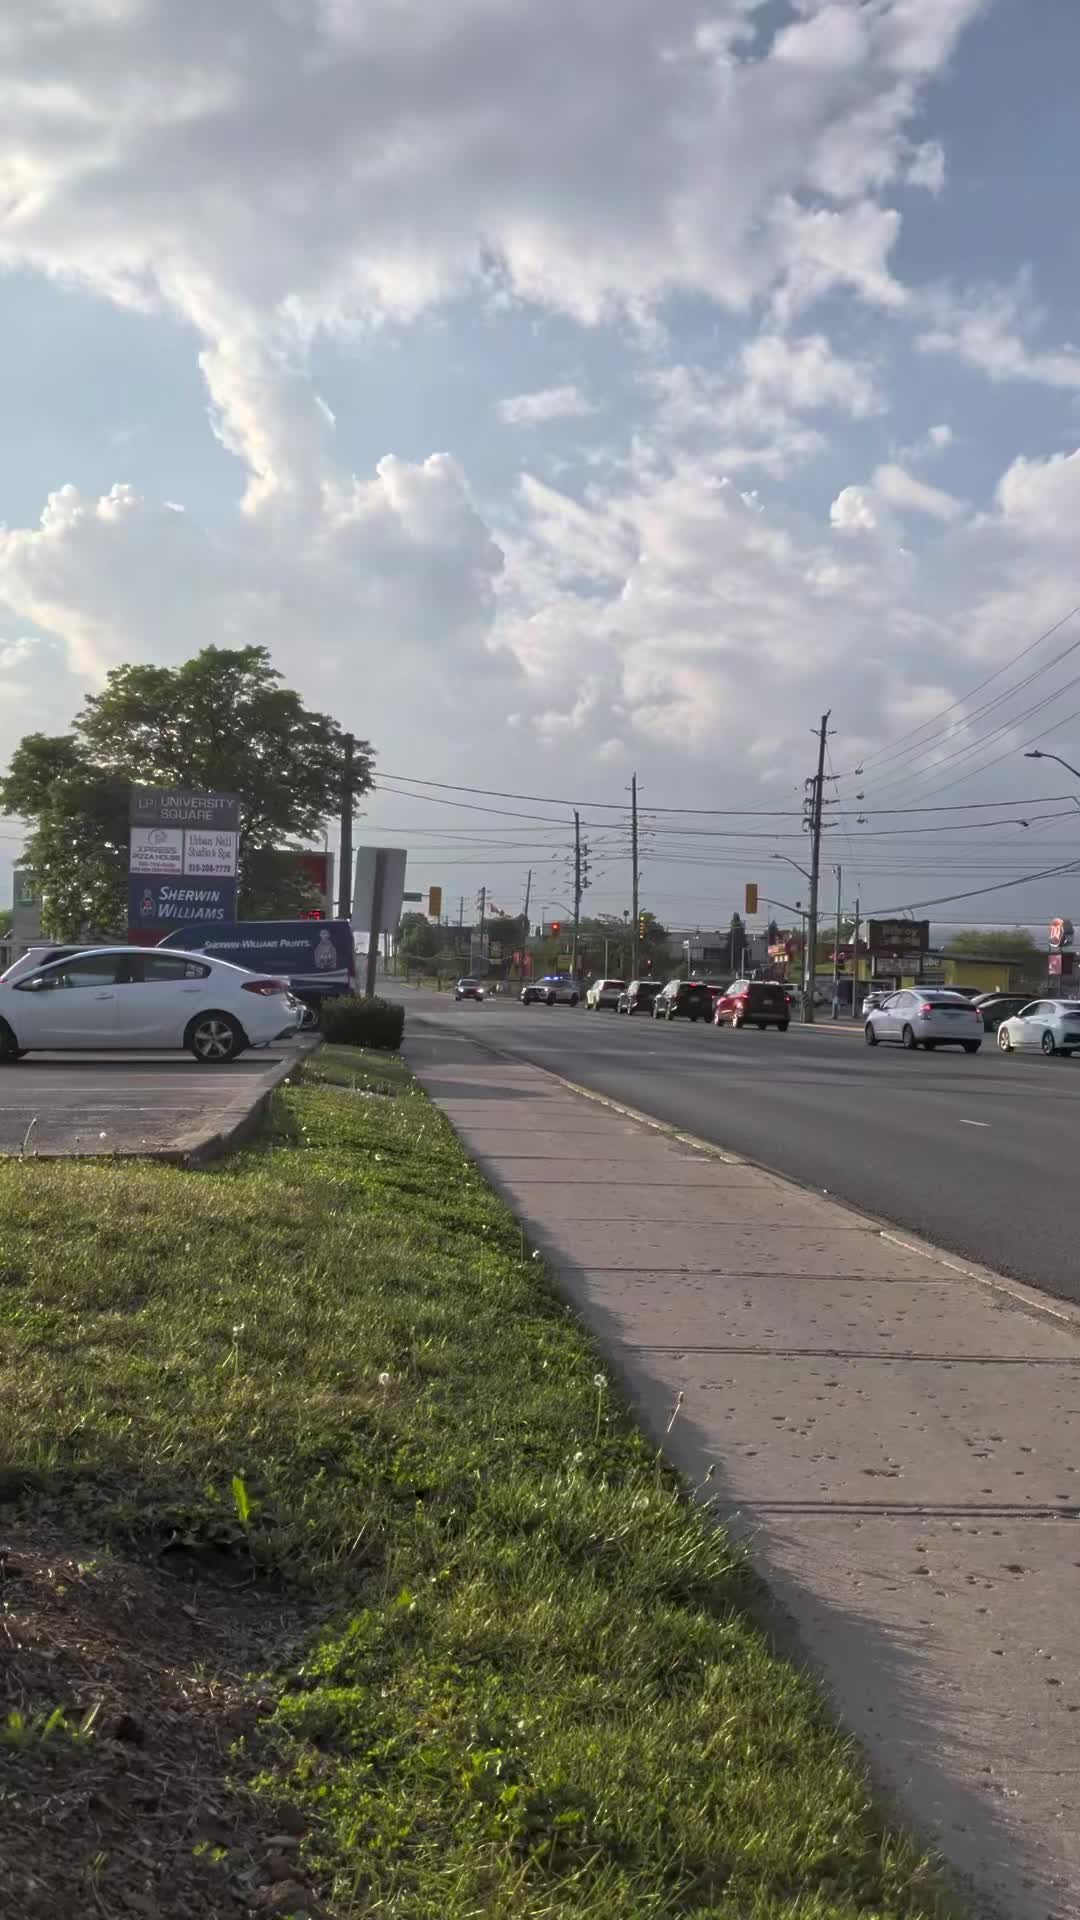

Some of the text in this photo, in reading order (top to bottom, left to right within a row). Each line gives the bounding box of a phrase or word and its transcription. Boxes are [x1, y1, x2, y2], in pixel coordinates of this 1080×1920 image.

[160, 796, 235, 809] UNIVERSITY
[160, 809, 214, 820] SQUARE
[188, 847, 211, 857] Studio
[217, 847, 232, 860] Spa
[159, 886, 220, 902] SHERWIN
[158, 904, 225, 920] WILLIAMS
